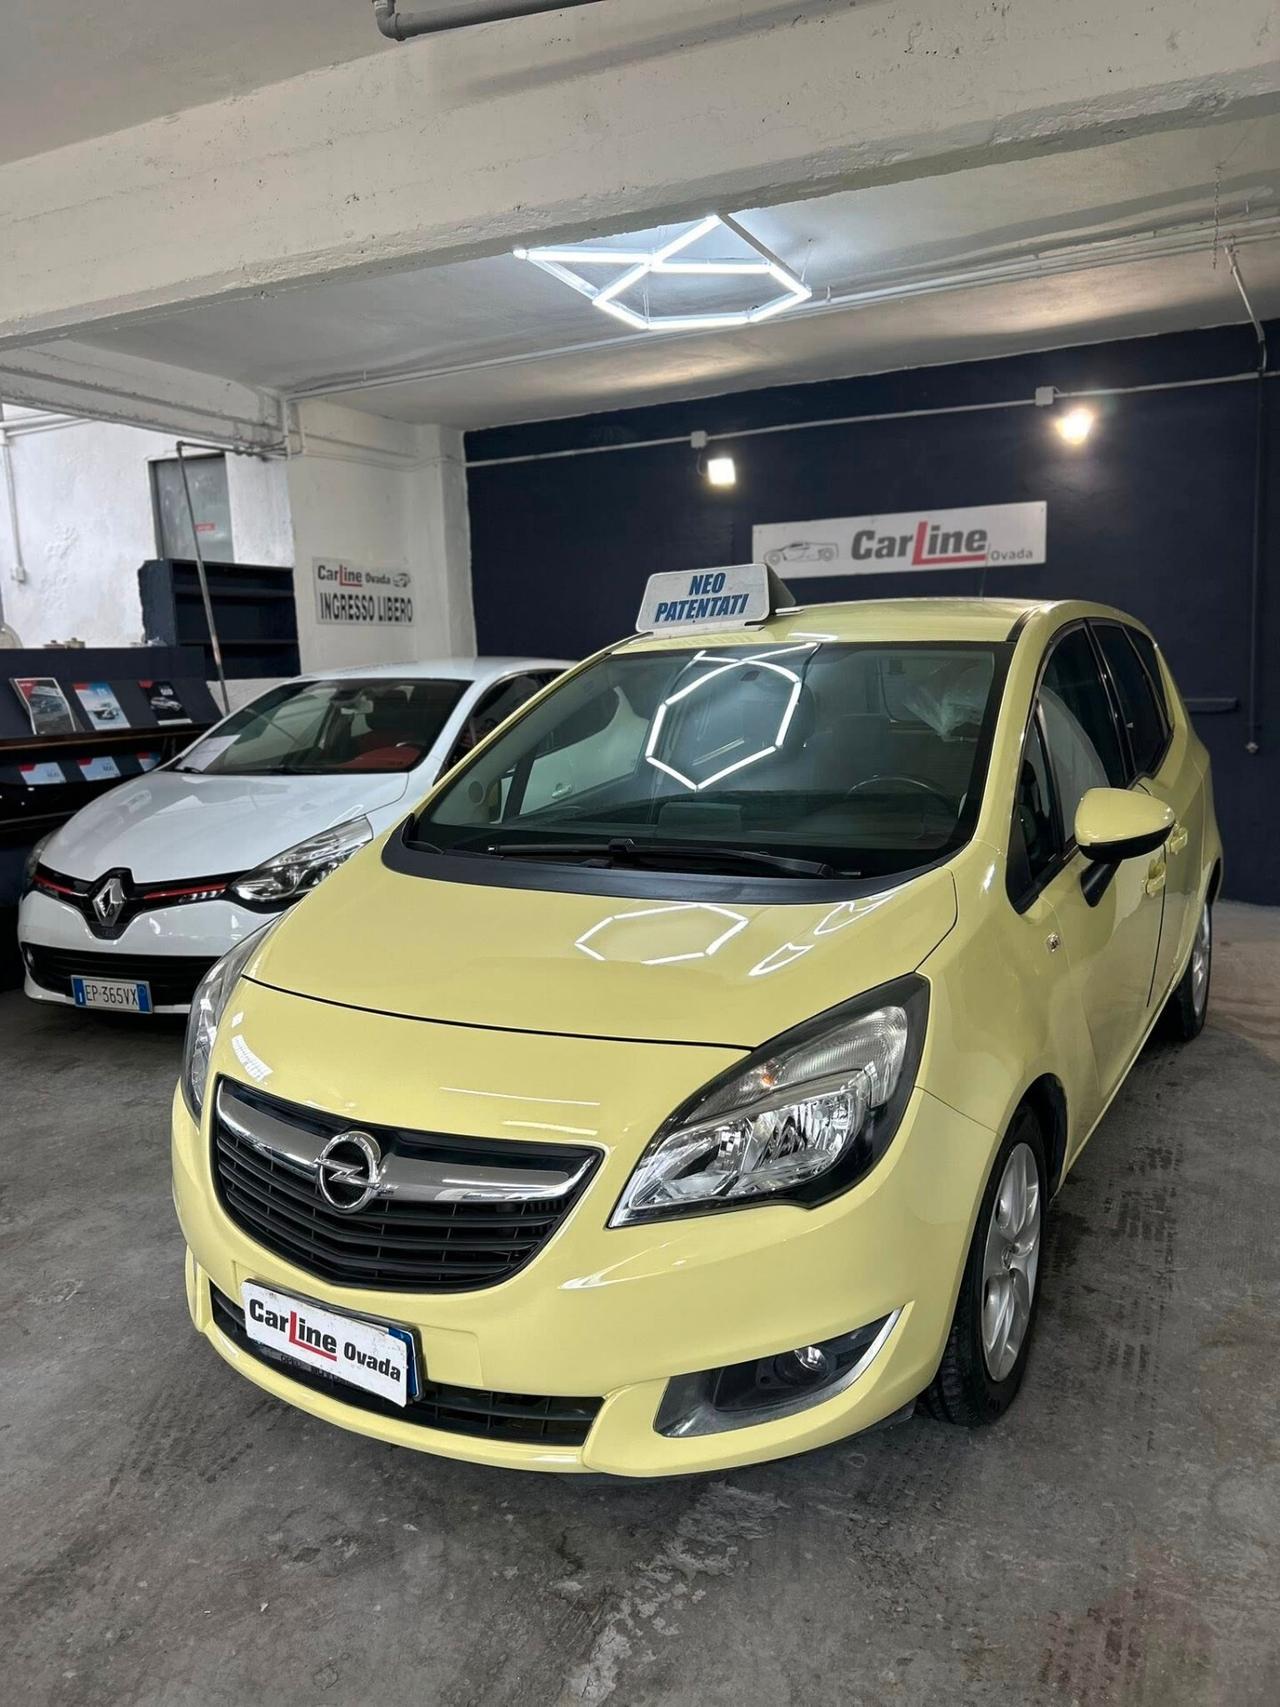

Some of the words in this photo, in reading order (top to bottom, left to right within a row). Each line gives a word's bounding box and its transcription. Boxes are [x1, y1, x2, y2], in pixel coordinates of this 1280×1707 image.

[851, 521, 988, 565] CarLine
[990, 549, 1033, 562] Ovada
[317, 564, 362, 587] CarLine
[365, 572, 391, 584] Ovada
[689, 572, 726, 596] NEO
[320, 592, 375, 620] INGRESSO
[378, 596, 413, 622] LIBERO
[654, 593, 749, 622] PATENTATI
[249, 1299, 337, 1361] CarLine
[344, 1342, 401, 1382] Ovada
